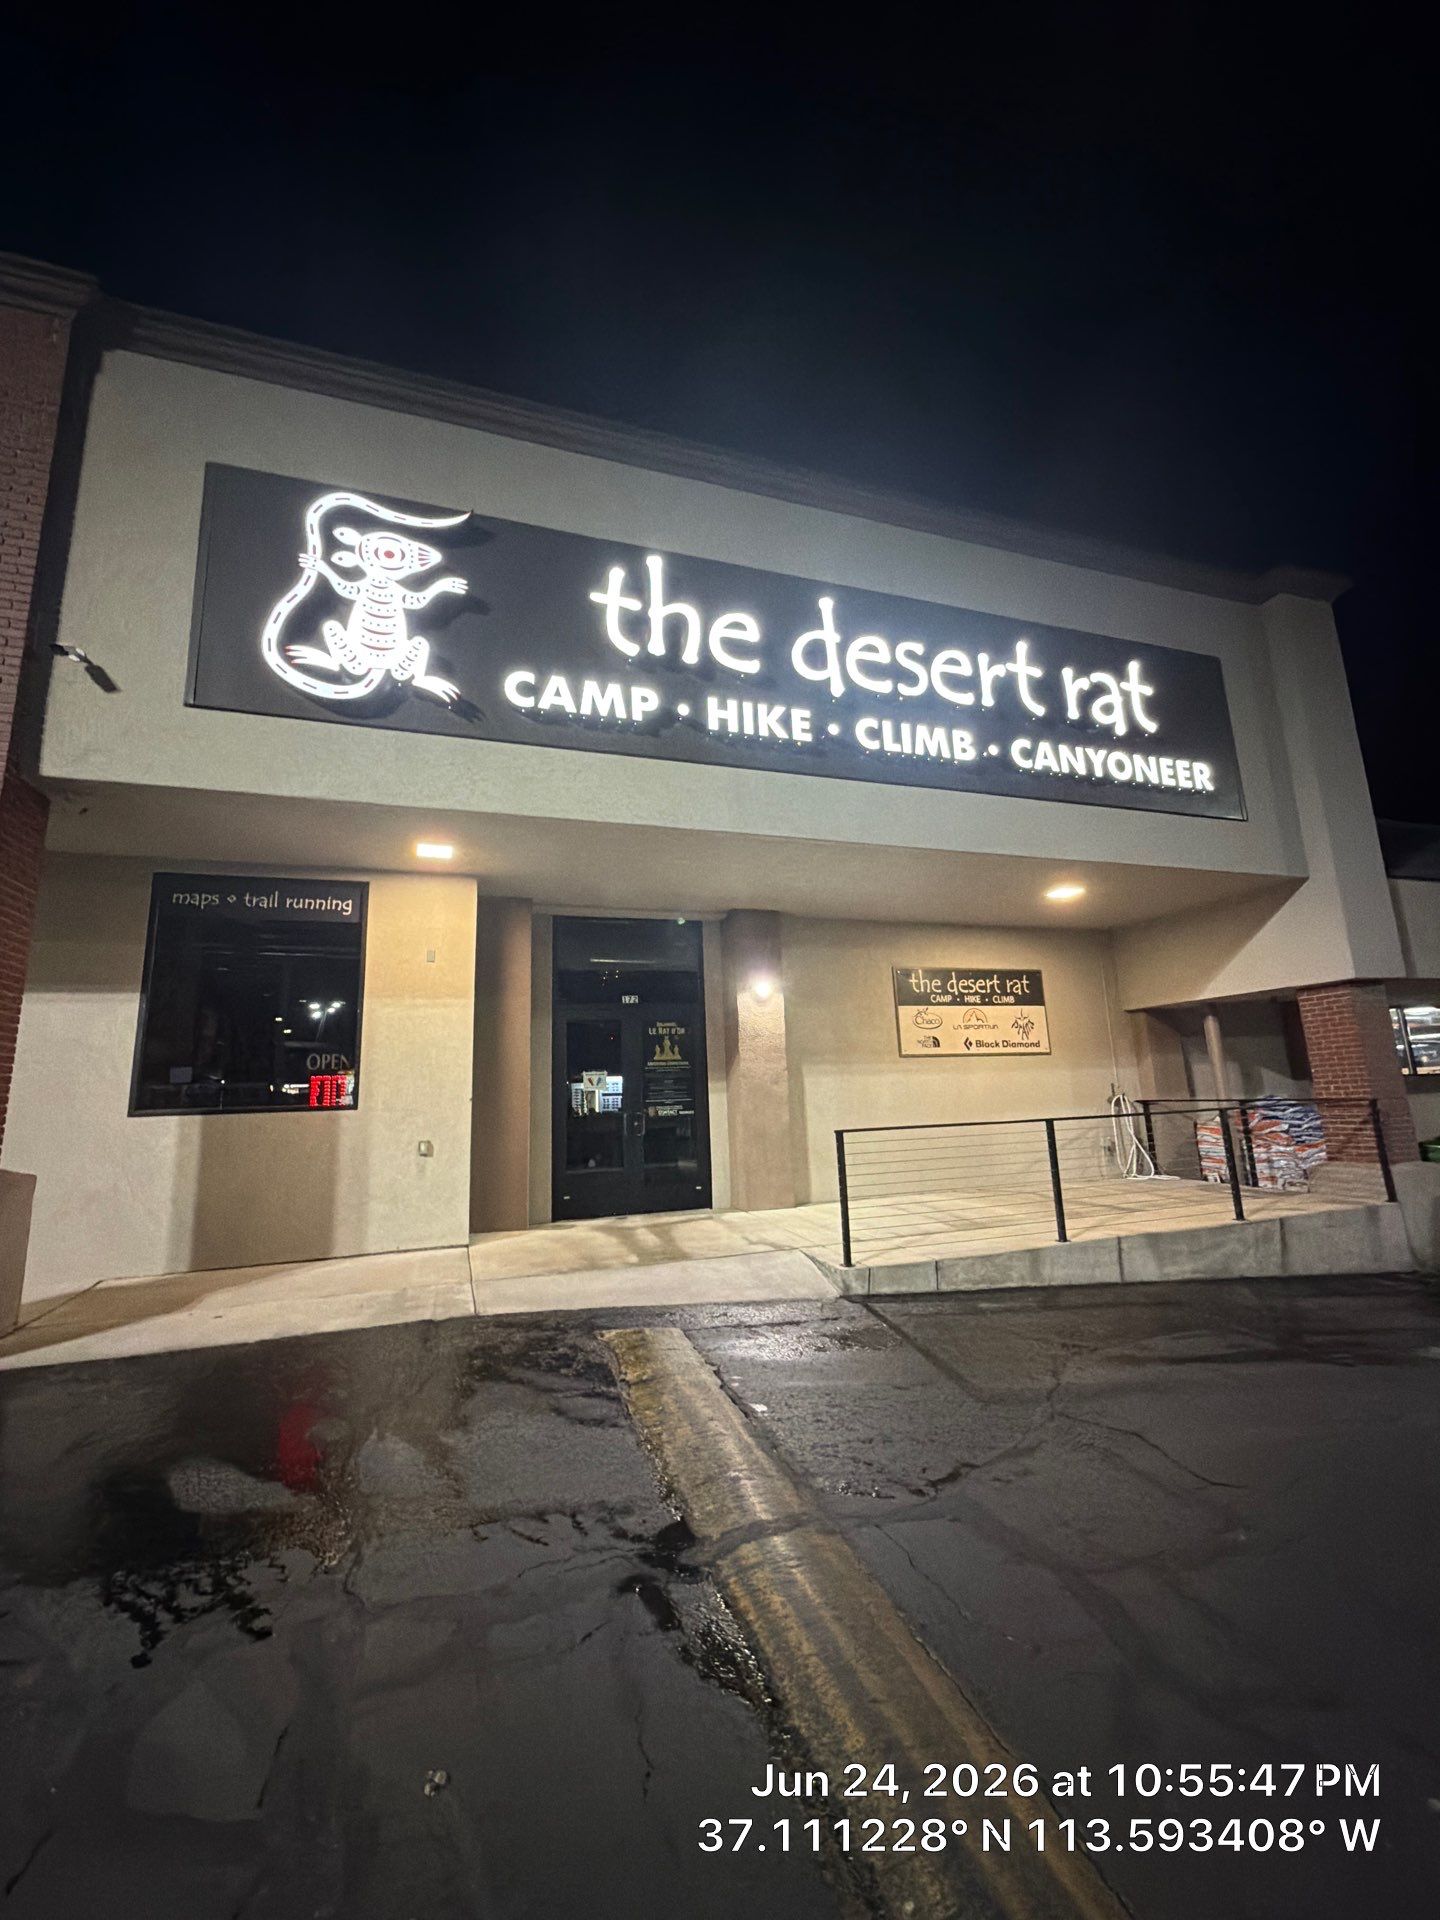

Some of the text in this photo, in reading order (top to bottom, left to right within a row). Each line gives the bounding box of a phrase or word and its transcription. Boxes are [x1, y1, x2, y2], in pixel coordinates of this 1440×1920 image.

[590, 555, 1158, 736] the desert rat
[504, 671, 1215, 791] CAMP HIKE CLIMB CANYONEER
[172, 890, 353, 916] maps trail running
[909, 969, 1030, 996] the desert rat
[930, 994, 1016, 1004] CAMP HIKE CLIMB
[914, 1015, 941, 1026] Chaco
[975, 1040, 1041, 1048] Black Diamond
[306, 1053, 350, 1070] OPEN
